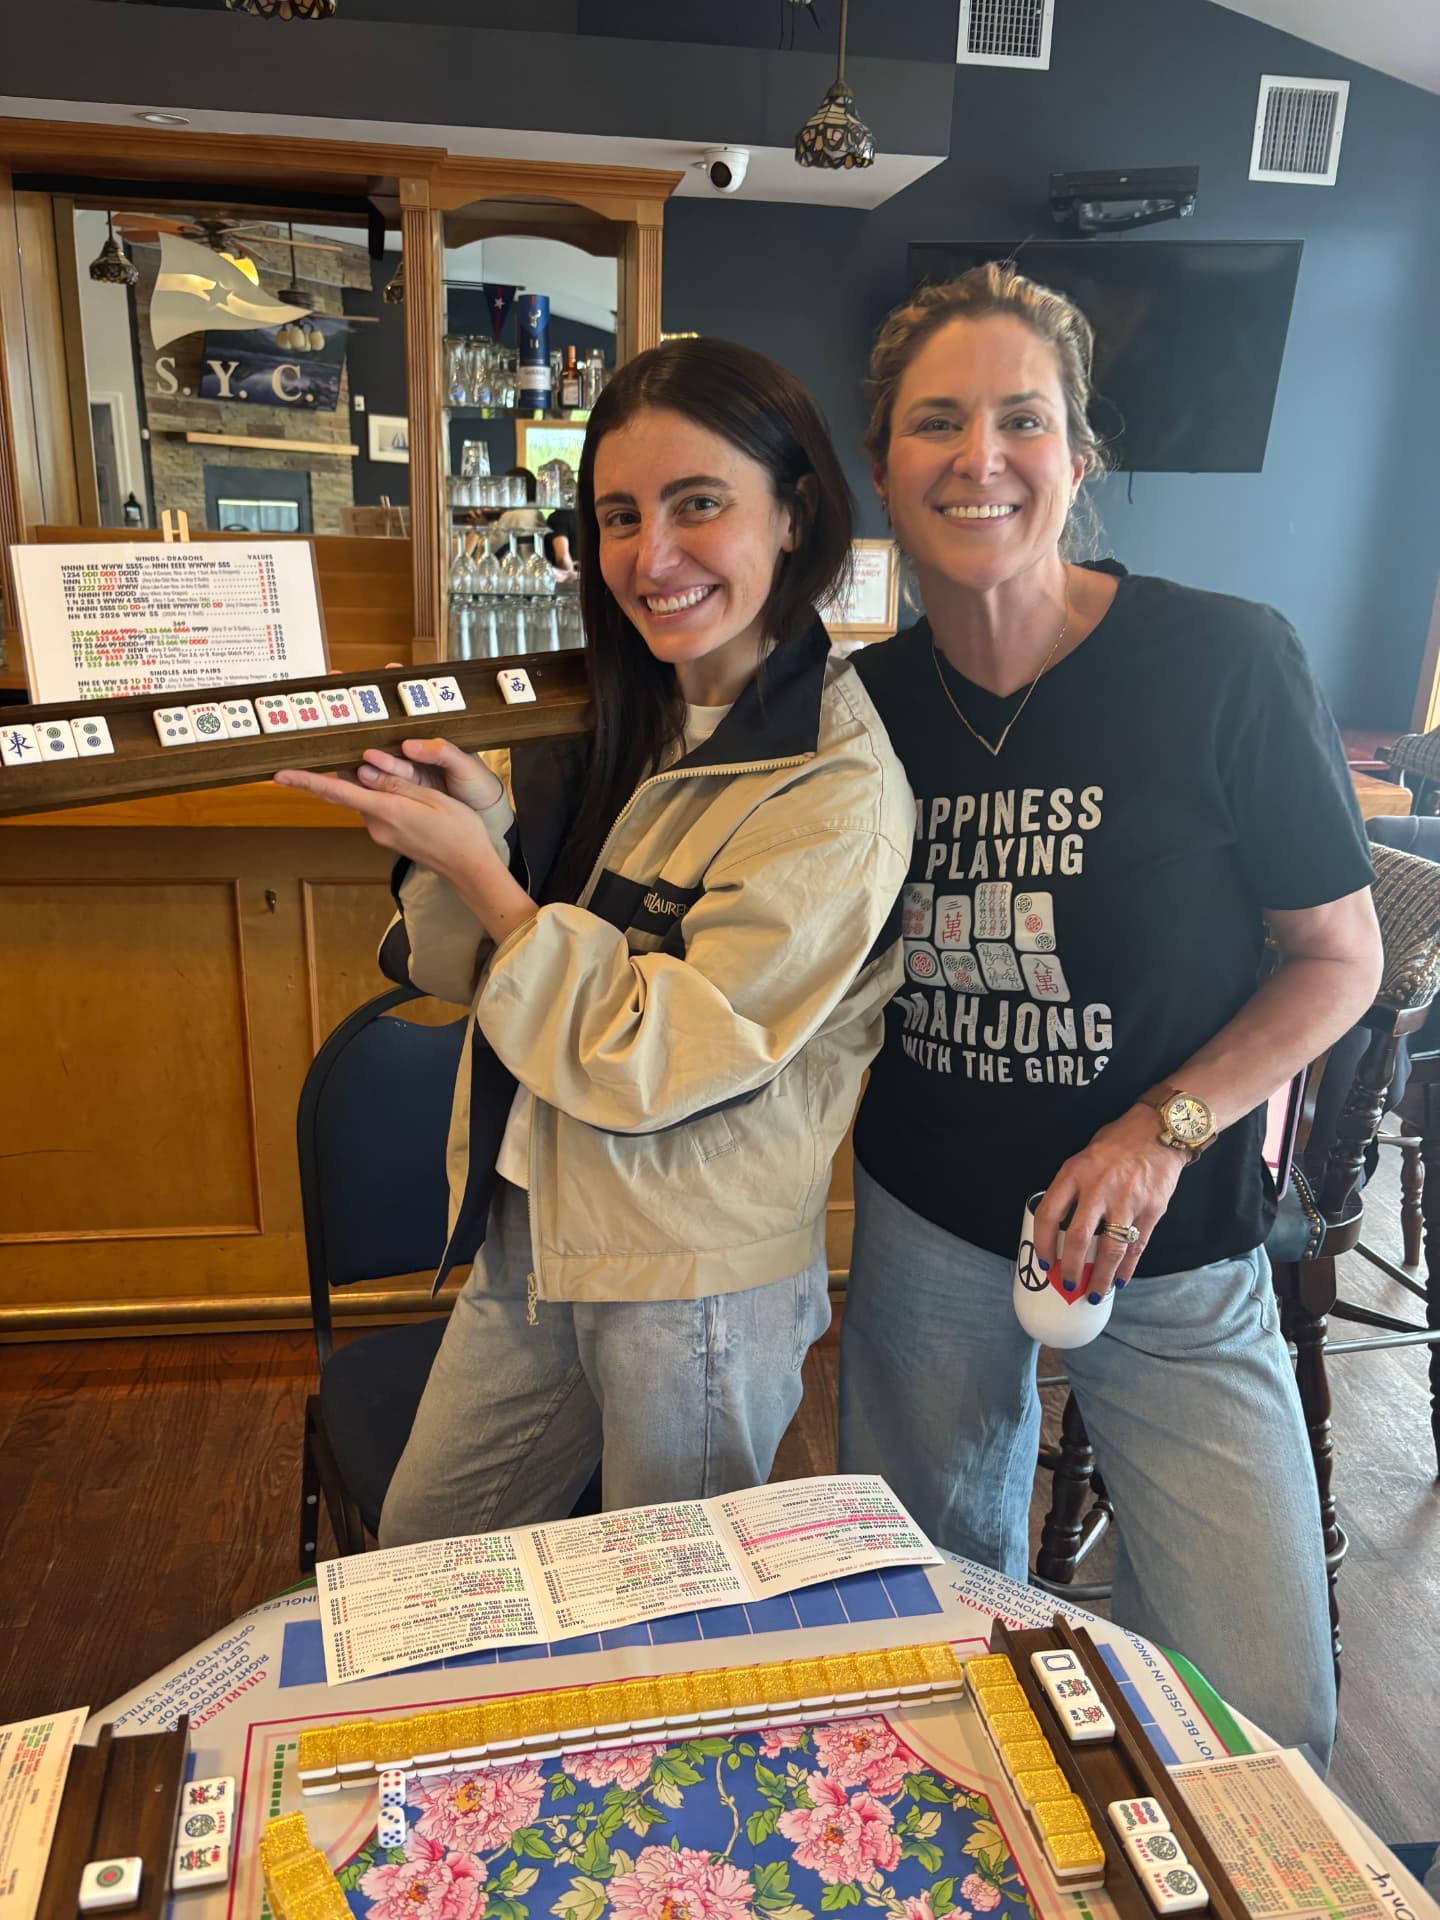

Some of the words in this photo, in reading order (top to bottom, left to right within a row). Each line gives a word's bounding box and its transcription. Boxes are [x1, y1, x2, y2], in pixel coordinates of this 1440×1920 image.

[155, 356, 191, 396] S.
[206, 360, 248, 398] Y.
[271, 364, 314, 402] C.
[914, 786, 1104, 840] APPINESS
[925, 834, 1084, 880] PLAYING
[892, 990, 1113, 1054] MAHJONG
[902, 1034, 952, 1074] WITH
[962, 1051, 1014, 1083] THE
[1024, 1055, 1110, 1086] GIRLS
[263, 1594, 318, 1611] INGLES
[965, 1579, 996, 1596] STOP
[997, 1592, 1012, 1606] TO
[1033, 1591, 1048, 1601] TO
[950, 1582, 1046, 1629] HT-ACROSS-LEFT
[957, 1594, 1030, 1632] ARLESTON
[1050, 1599, 1096, 1622] OPTION
[213, 1624, 256, 1656] OPTION
[1123, 1628, 1157, 1667] SINGLE
[196, 1655, 214, 1667] TO
[206, 1654, 250, 1688] OPTION
[1151, 1670, 1165, 1682] IN
[189, 1687, 208, 1700] TO
[189, 1670, 267, 1731] CHARLESTO
[1161, 1684, 1187, 1717] USED
[157, 1699, 189, 1726] STOP
[1182, 1719, 1200, 1736] BE
[1135, 1838, 1154, 1863] JOKER
[1153, 1872, 1174, 1898] JOKER
[1366, 1863, 1416, 1920] Only
